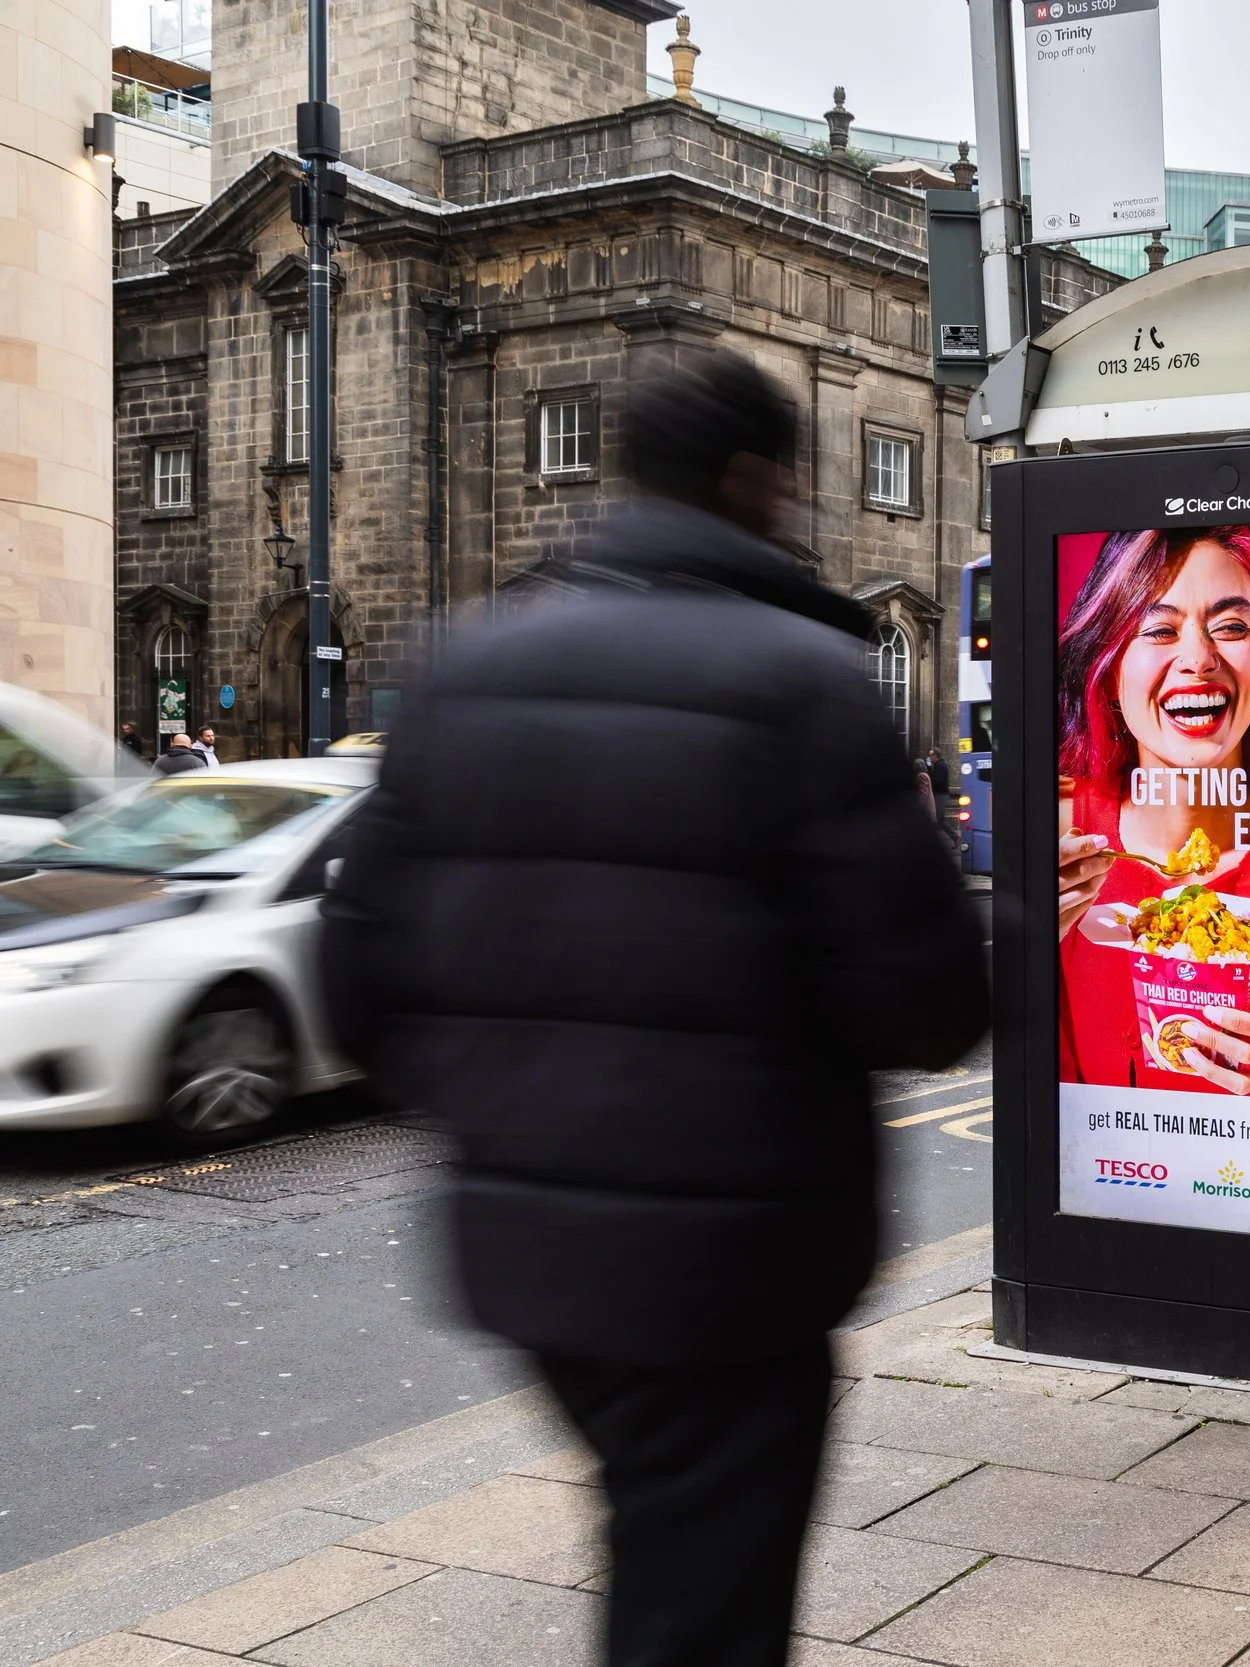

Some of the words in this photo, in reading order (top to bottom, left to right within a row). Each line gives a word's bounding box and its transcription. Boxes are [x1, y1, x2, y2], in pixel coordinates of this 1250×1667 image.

[1067, 3, 1088, 14] bus
[1091, 0, 1117, 11] stop
[1055, 27, 1092, 41] Trinity
[1037, 50, 1060, 61] Drop
[1061, 46, 1074, 57] off
[1076, 44, 1096, 56] only
[1113, 196, 1159, 208] wymetro.com
[1120, 209, 1155, 219] 45010688
[1098, 359, 1128, 375] 0113
[1133, 356, 1160, 372] 245
[1186, 498, 1224, 513] Clear
[1130, 767, 1247, 807] GETTING
[1141, 982, 1165, 999] THAI
[1167, 987, 1188, 1003] RED
[1189, 990, 1236, 1008] CHICKEN
[1088, 1112, 1111, 1131] get
[1115, 1111, 1149, 1132] REAL
[1153, 1114, 1184, 1134] THAI
[1189, 1116, 1236, 1139] MEALS
[1094, 1158, 1168, 1181] TESCO
